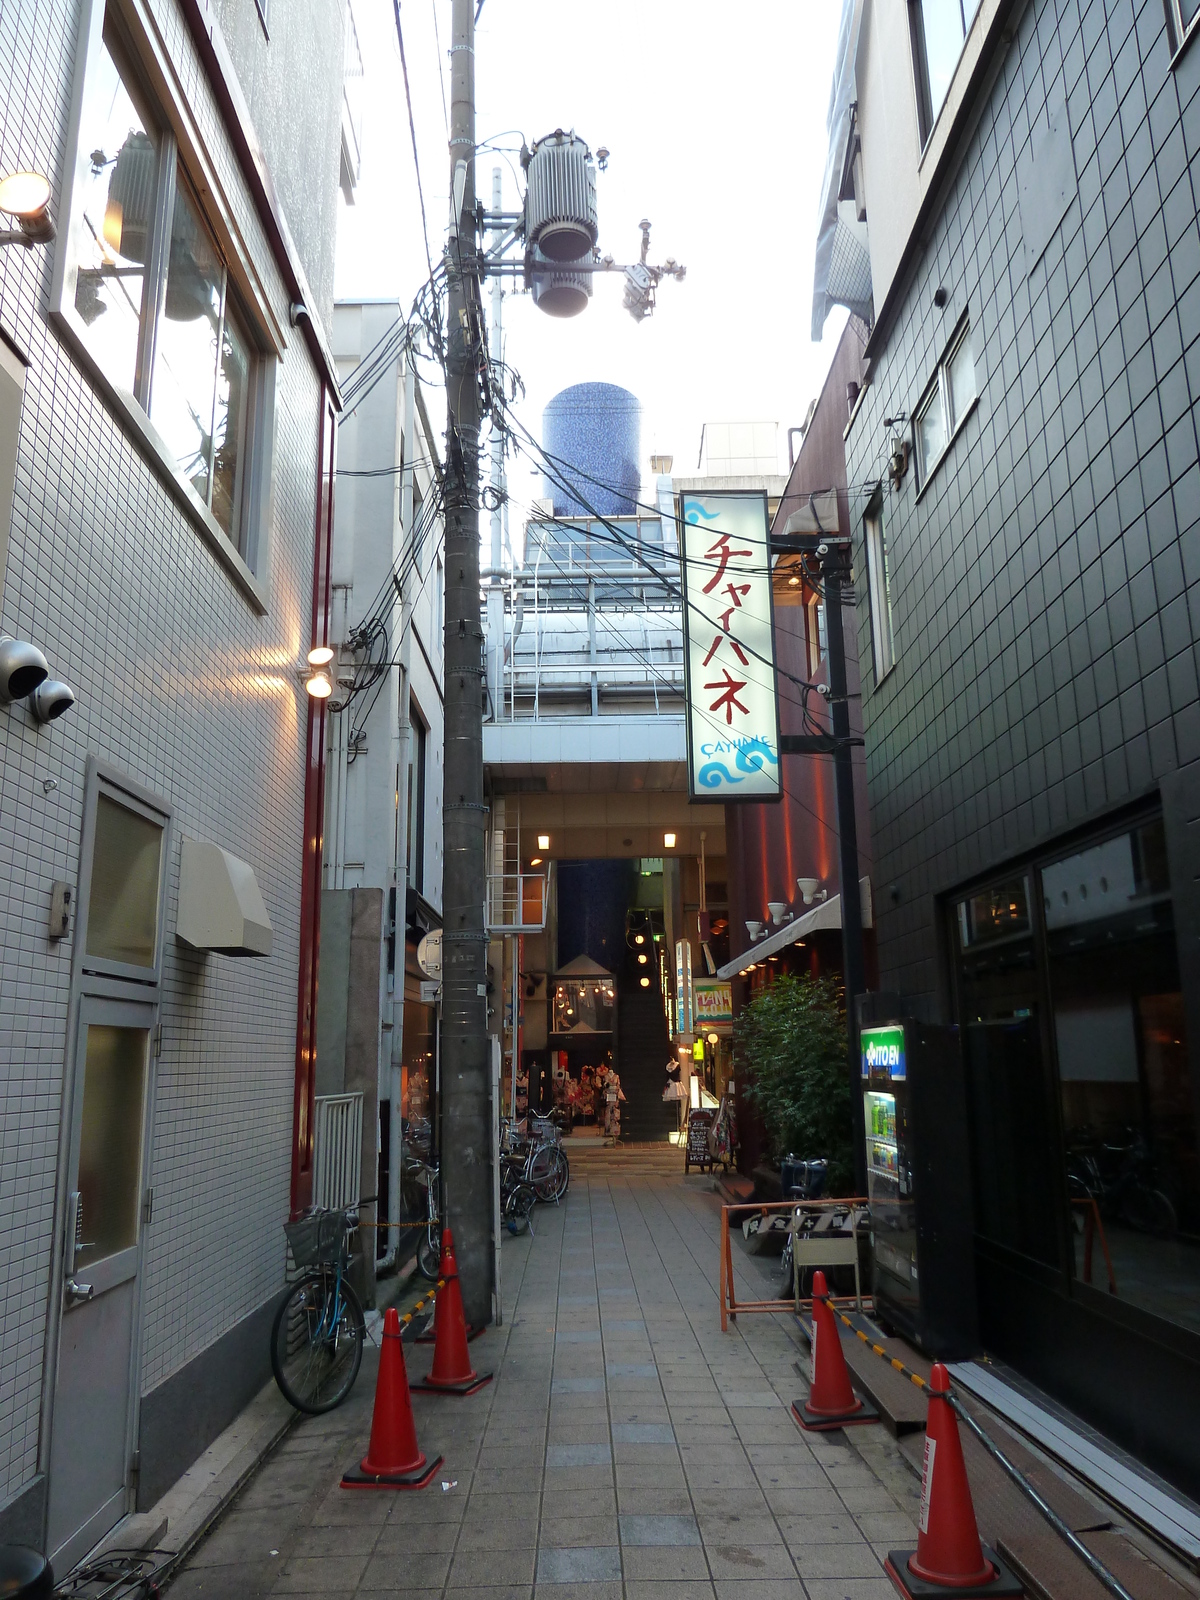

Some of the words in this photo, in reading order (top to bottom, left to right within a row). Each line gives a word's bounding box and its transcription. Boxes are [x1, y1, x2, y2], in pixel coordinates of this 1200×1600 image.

[702, 534, 753, 725] チャイハネ
[875, 1045, 888, 1066] ITO
[889, 1044, 899, 1066] EN
